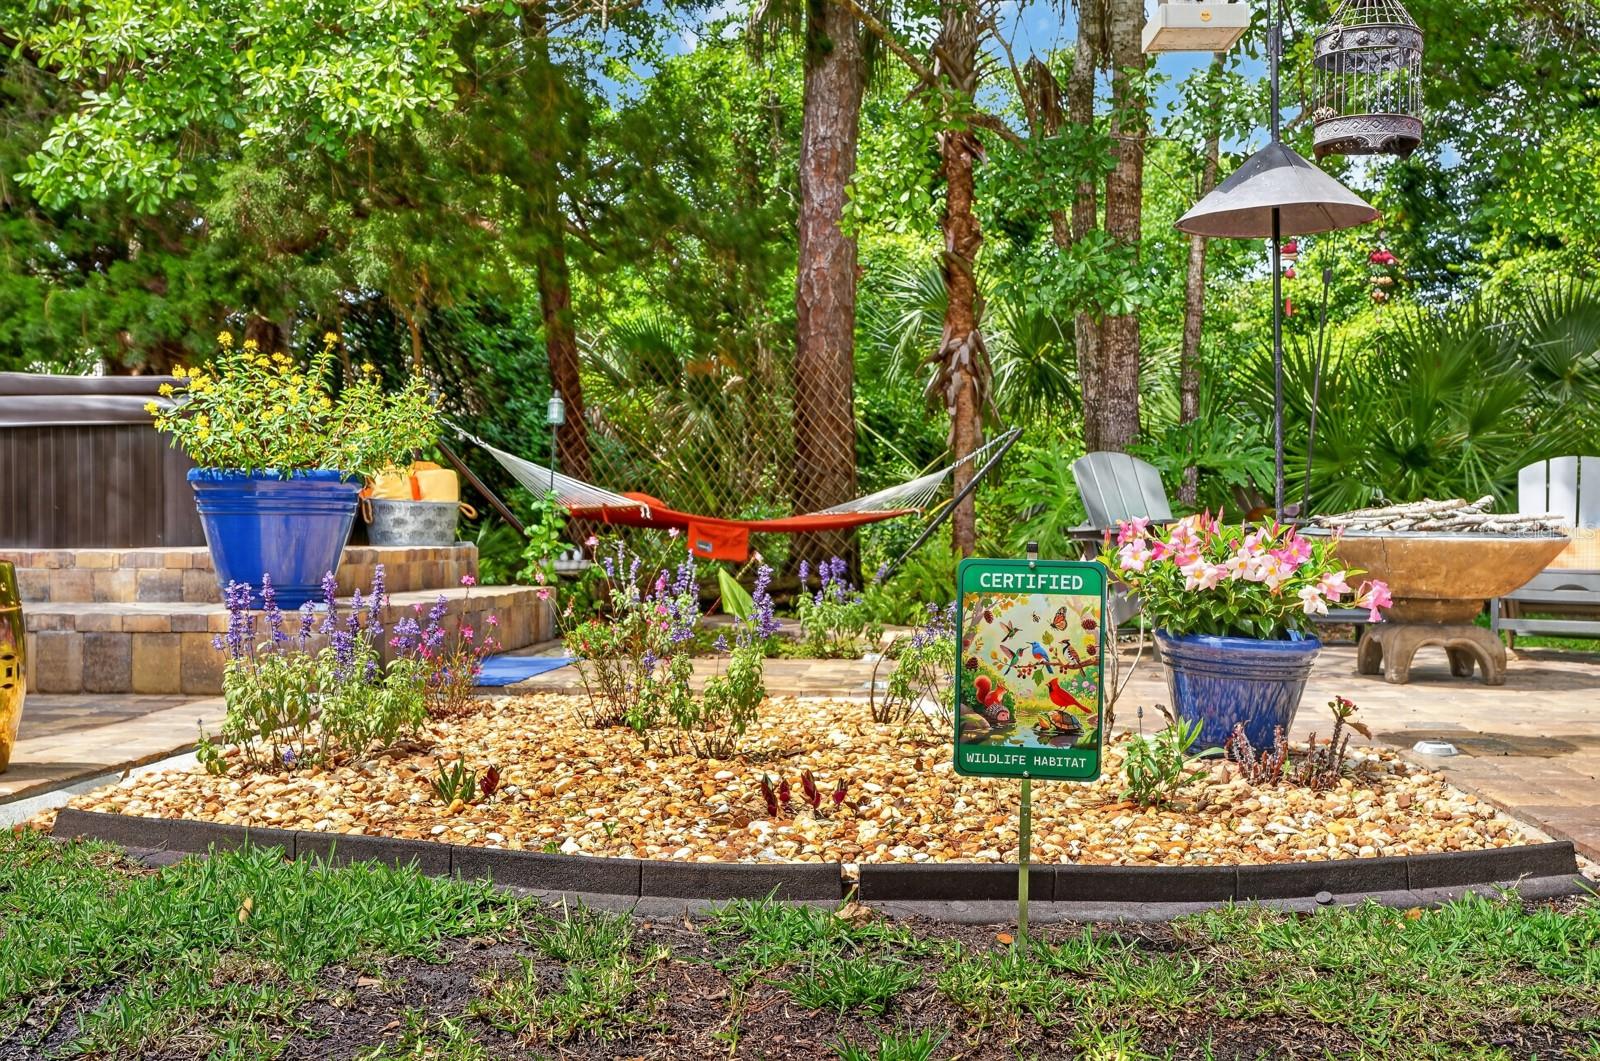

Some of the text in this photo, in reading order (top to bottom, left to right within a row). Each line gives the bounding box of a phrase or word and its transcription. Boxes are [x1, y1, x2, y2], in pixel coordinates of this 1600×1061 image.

[980, 572, 1083, 590] CERTIFIED
[966, 752, 1087, 768] WILDLIFE HABITAT
